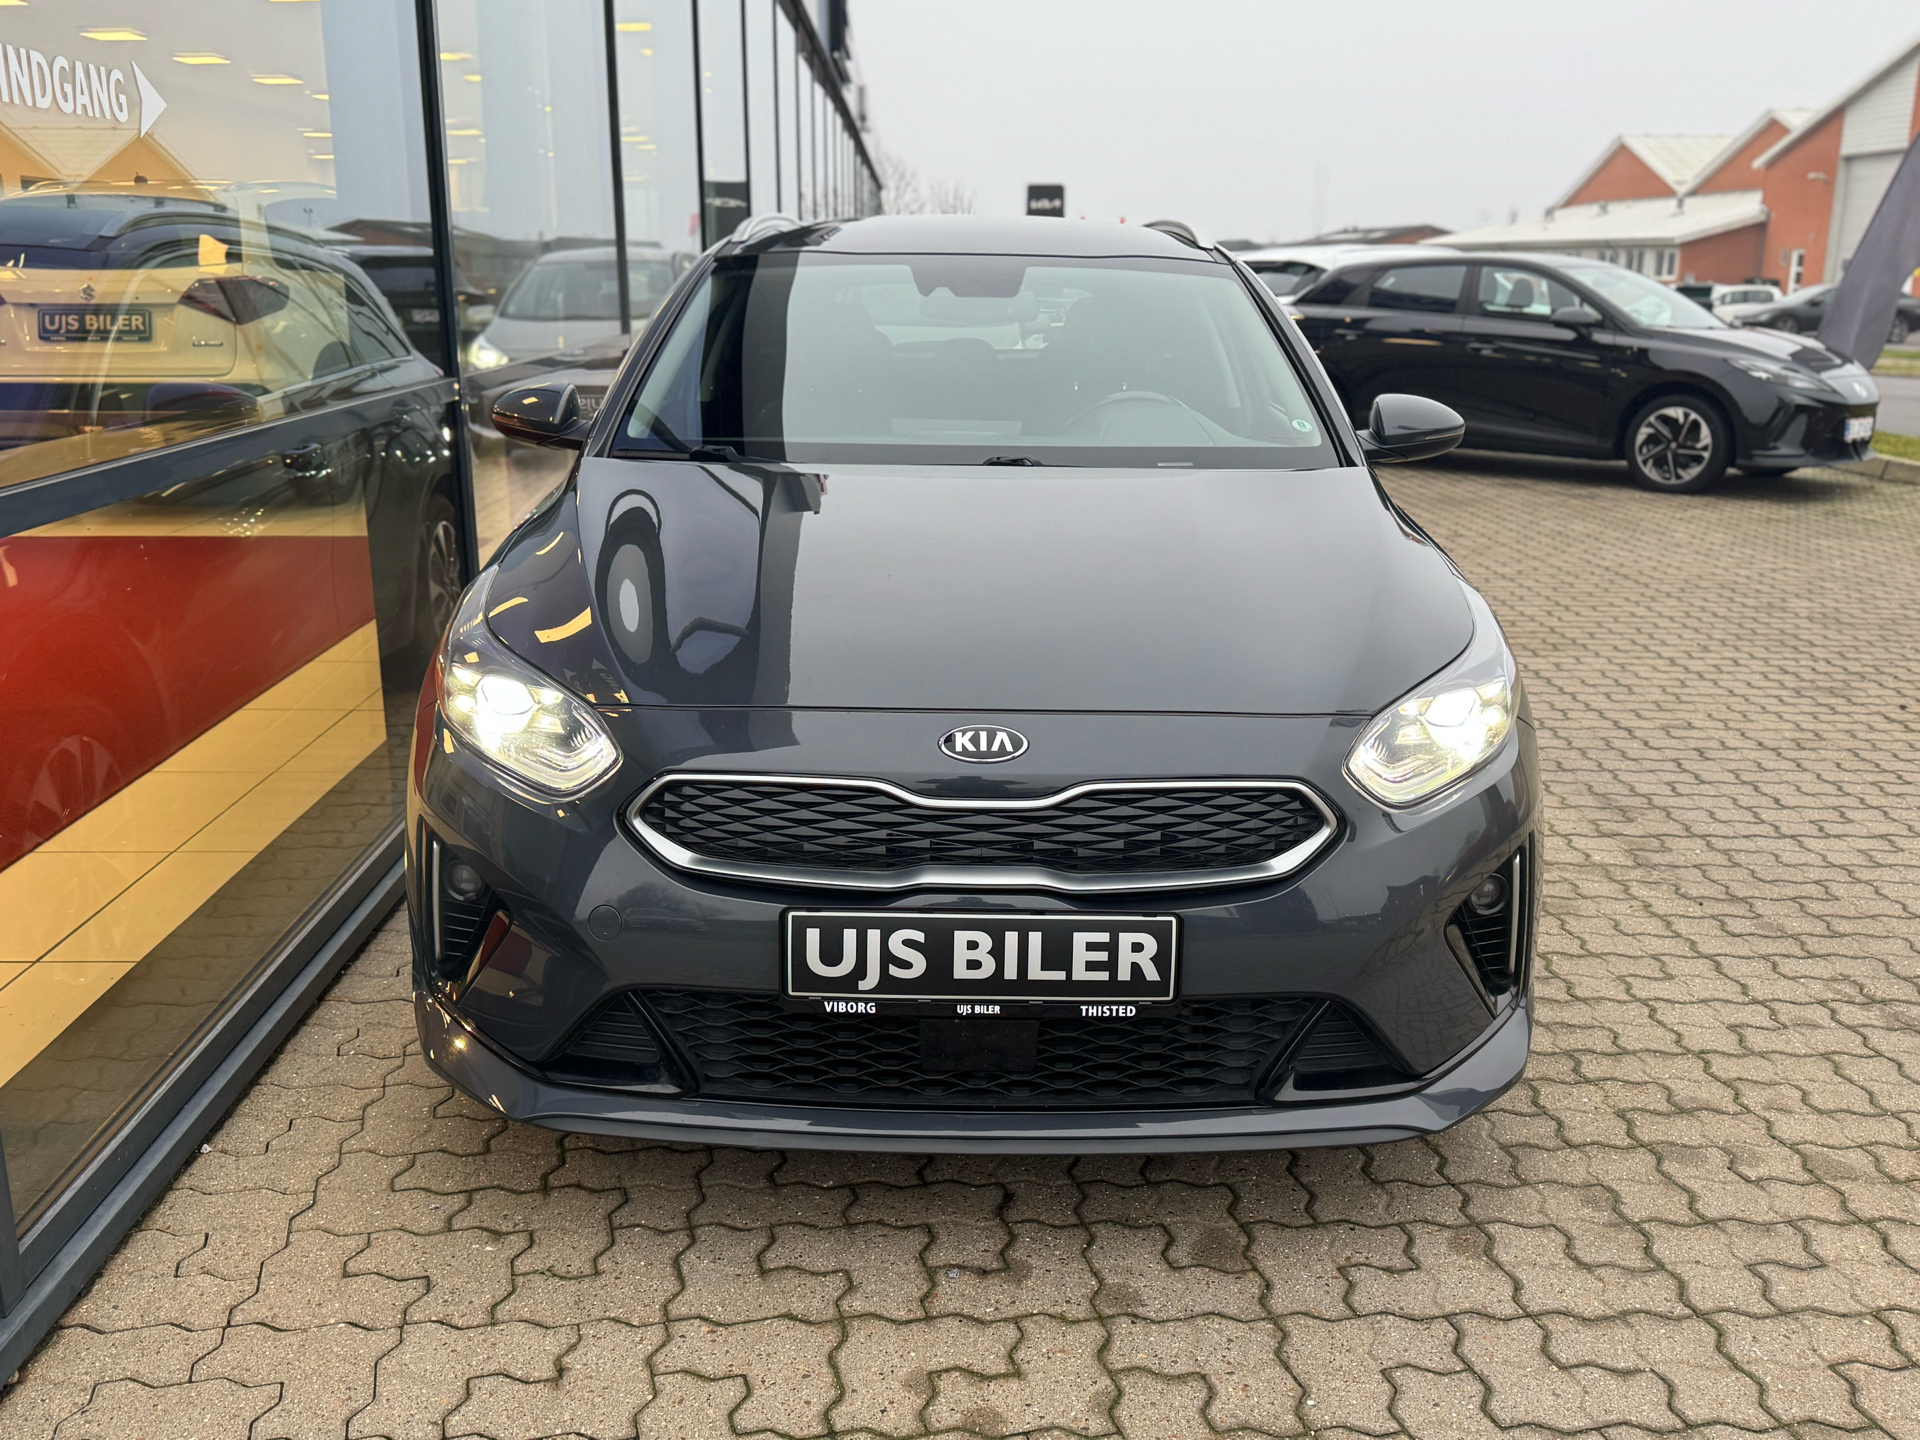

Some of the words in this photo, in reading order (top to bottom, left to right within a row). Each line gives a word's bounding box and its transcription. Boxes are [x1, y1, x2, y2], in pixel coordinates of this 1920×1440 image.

[0, 43, 129, 123] INDGANG
[44, 314, 80, 334] UJS
[85, 314, 145, 331] BILER
[954, 730, 1014, 752] KIA
[805, 928, 927, 991] UJS
[952, 930, 1161, 981] BILER
[823, 1001, 876, 1014] VIBORG
[956, 1004, 972, 1016] UJS
[974, 1005, 1001, 1014] BILER
[1080, 1005, 1136, 1017] THISTED
